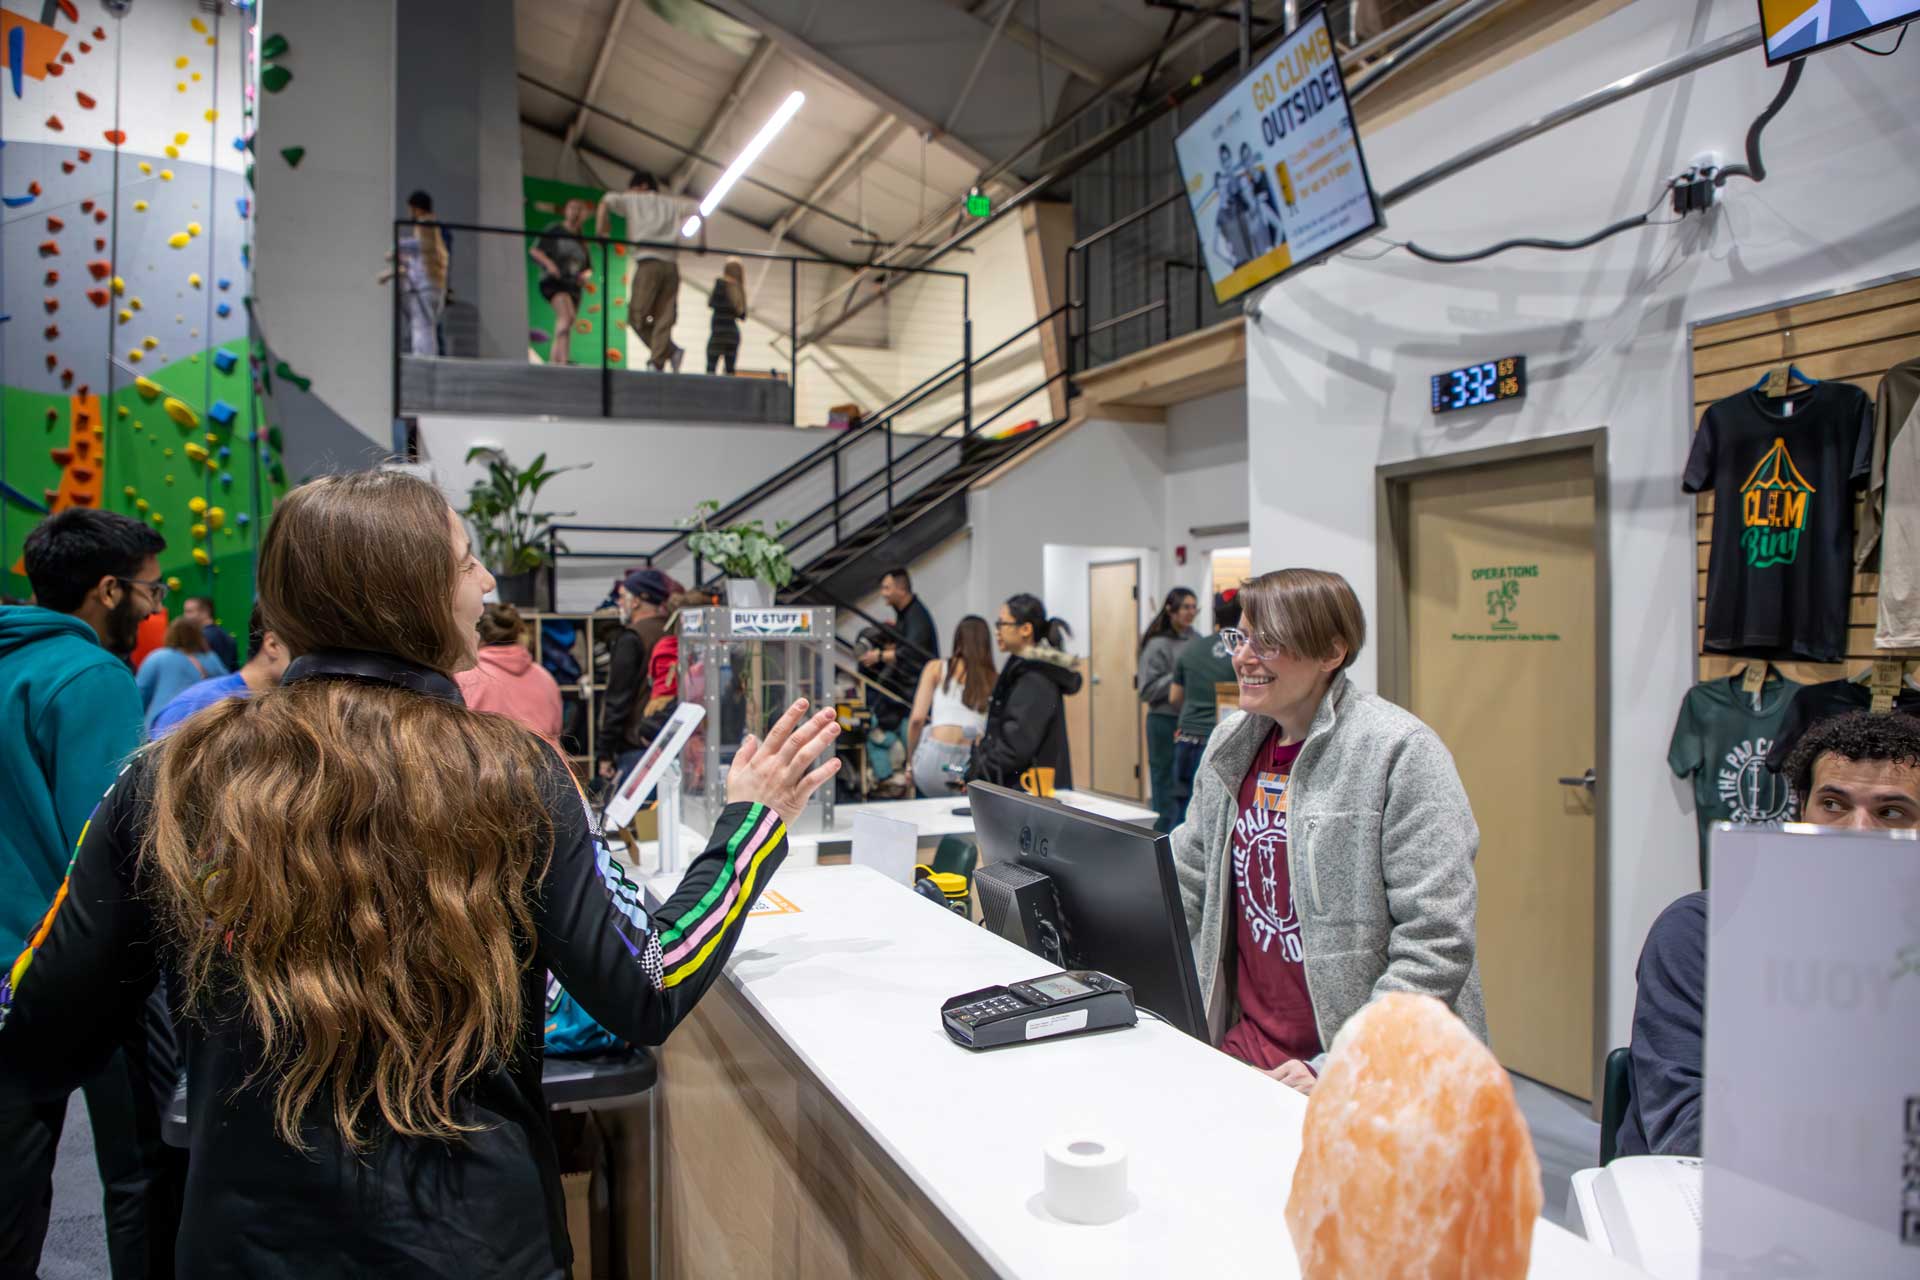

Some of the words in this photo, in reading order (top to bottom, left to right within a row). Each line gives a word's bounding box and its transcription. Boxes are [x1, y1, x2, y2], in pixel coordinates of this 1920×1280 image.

[1252, 72, 1276, 112] GO
[1276, 27, 1333, 92] CLIMB
[1471, 564, 1539, 581] OPERATIONS
[735, 613, 758, 624] BUY
[762, 613, 797, 624] STUFF
[1725, 739, 1753, 769] PAD
[1718, 768, 1738, 802] THE
